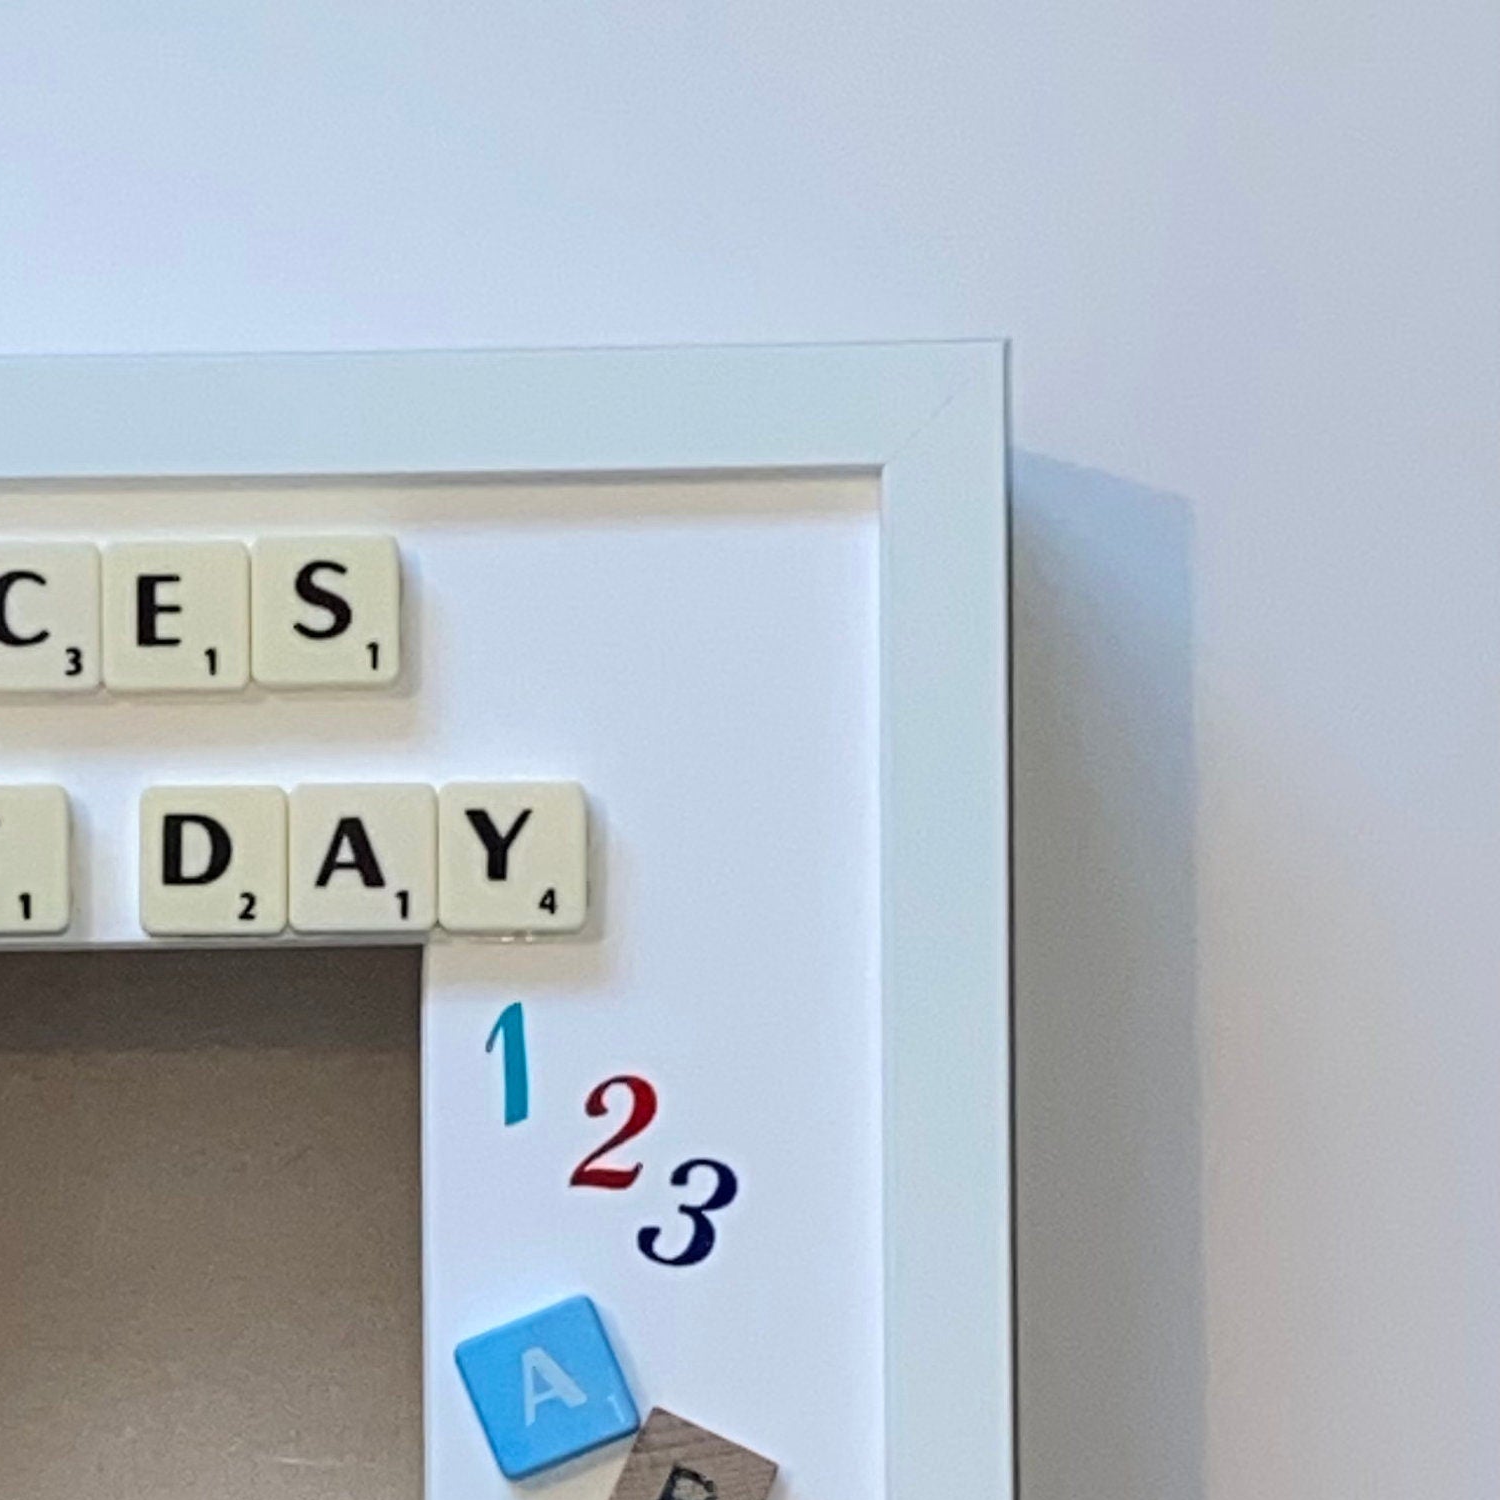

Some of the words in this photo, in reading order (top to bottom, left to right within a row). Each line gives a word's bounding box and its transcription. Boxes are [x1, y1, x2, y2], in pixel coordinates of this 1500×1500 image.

[64, 647, 83, 677] 3
[203, 648, 218, 677] 1
[364, 641, 380, 671] 1
[161, 807, 534, 890] DAY
[17, 892, 33, 920] 1
[237, 891, 257, 921] 2
[394, 890, 409, 920] 1
[537, 887, 557, 916] 4
[485, 1001, 528, 1126] 1
[569, 1074, 658, 1190] 2
[636, 1158, 738, 1268] 3
[519, 1346, 588, 1427] A
